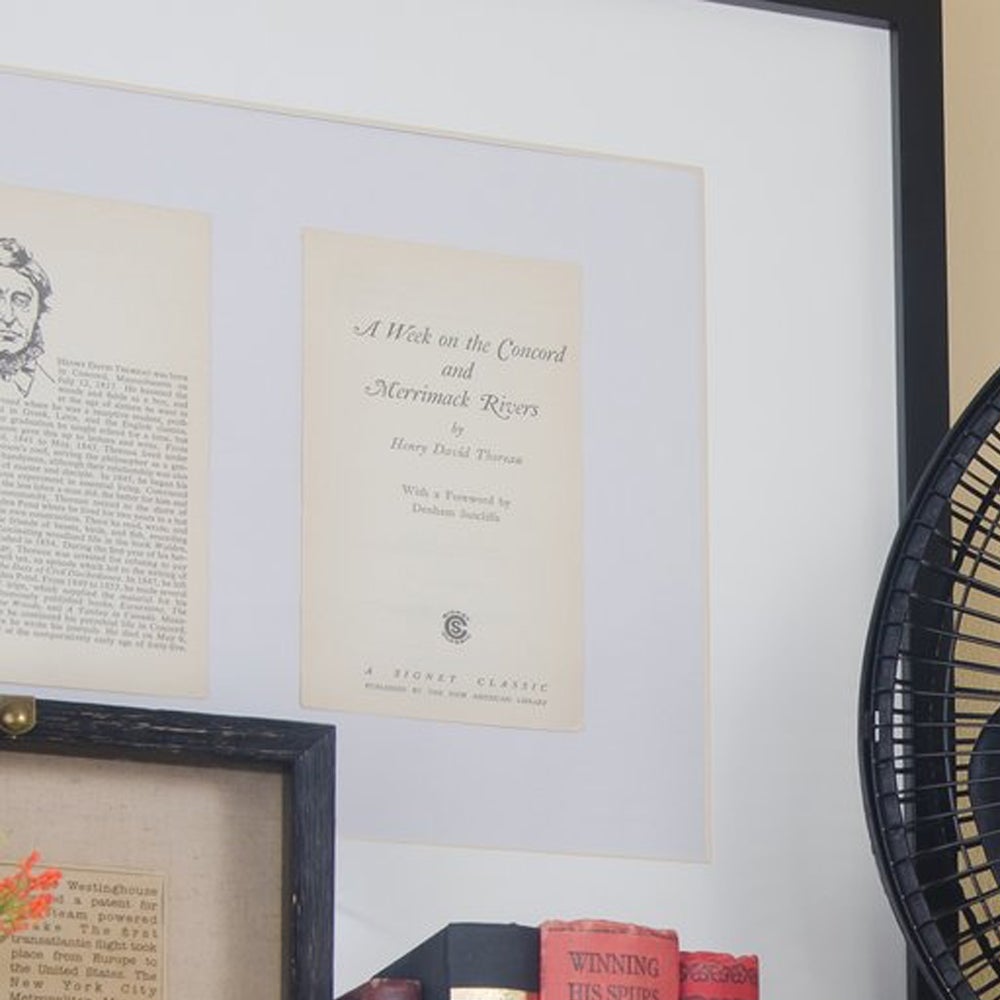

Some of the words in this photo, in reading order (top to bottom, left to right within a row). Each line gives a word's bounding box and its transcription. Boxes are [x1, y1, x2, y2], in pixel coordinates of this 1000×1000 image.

[353, 320, 381, 338] A
[386, 322, 432, 345] Week
[439, 335, 458, 348] on
[466, 334, 492, 354] the
[497, 338, 568, 363] Concord
[440, 362, 475, 380] and
[365, 378, 471, 408] Merrimack
[480, 393, 540, 420] Rivers
[451, 422, 464, 437] by
[390, 437, 428, 456] Henry
[433, 443, 471, 458] David
[402, 484, 429, 497] With
[365, 666, 372, 675] A
[394, 669, 457, 684] SIGNET
[477, 677, 549, 692] CLASSIC
[67, 880, 158, 896] Westinghouse
[91, 898, 131, 909] patent
[140, 900, 158, 910] for
[98, 912, 158, 925] powered
[11, 934, 92, 948] transatlantic
[11, 948, 43, 960] place
[53, 950, 83, 962] from
[93, 953, 137, 967] Europe
[568, 951, 660, 977] WINNING
[10, 963, 31, 973] the
[38, 964, 79, 975] United
[135, 970, 157, 981] The
[9, 977, 44, 988] New
[62, 980, 103, 992] York
[120, 984, 157, 998] City
